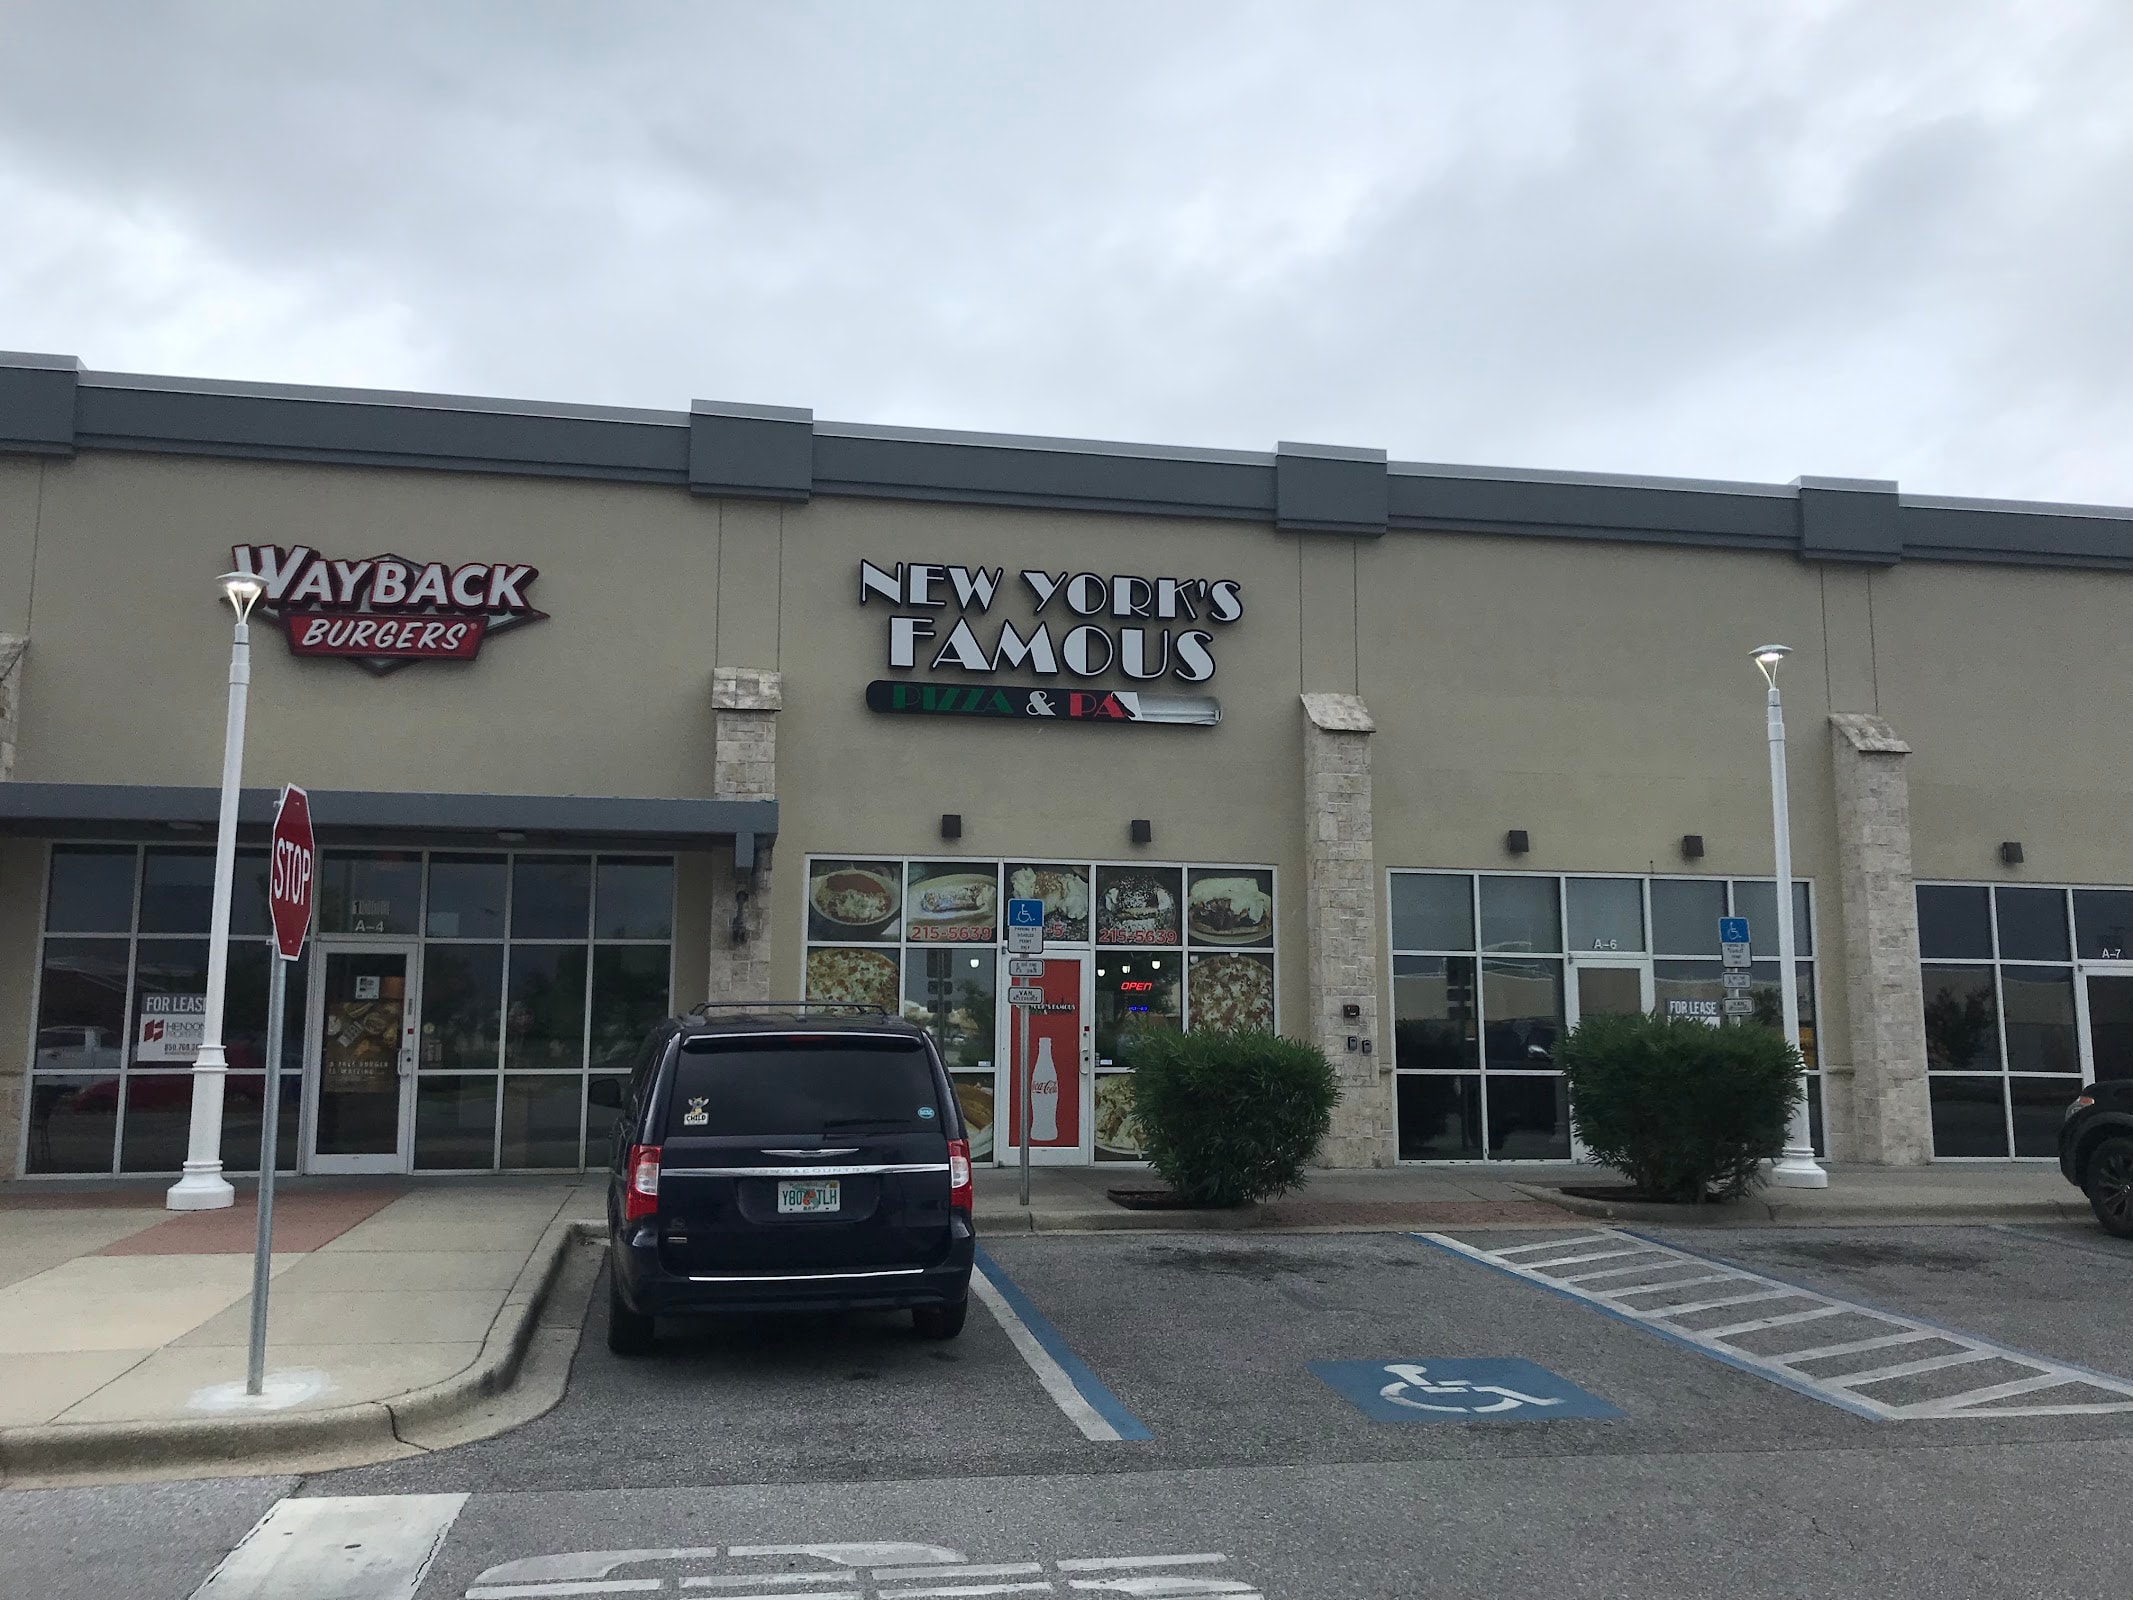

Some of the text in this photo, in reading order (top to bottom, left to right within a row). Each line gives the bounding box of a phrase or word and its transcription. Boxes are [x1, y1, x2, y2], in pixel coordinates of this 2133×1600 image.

[231, 544, 537, 609] WAYBACK
[860, 559, 1244, 623] NEW YORK'S
[302, 617, 468, 651] BURGERS
[888, 616, 1216, 682] FAMOUS
[892, 684, 1014, 714] PIZZA
[1025, 690, 1057, 717] &
[274, 837, 312, 906] STOP
[355, 919, 385, 932] A-4
[911, 925, 993, 942] 215-5639
[1099, 928, 1178, 944] 215-5639
[1594, 938, 1617, 950] A-6
[2101, 947, 2122, 959] A-7
[1120, 982, 1153, 991] OPEN
[146, 996, 170, 1012] FOR
[1669, 1000, 1688, 1015] FOR
[1689, 1001, 1717, 1015] LEASE
[1032, 1080, 1058, 1095] ca-Cola
